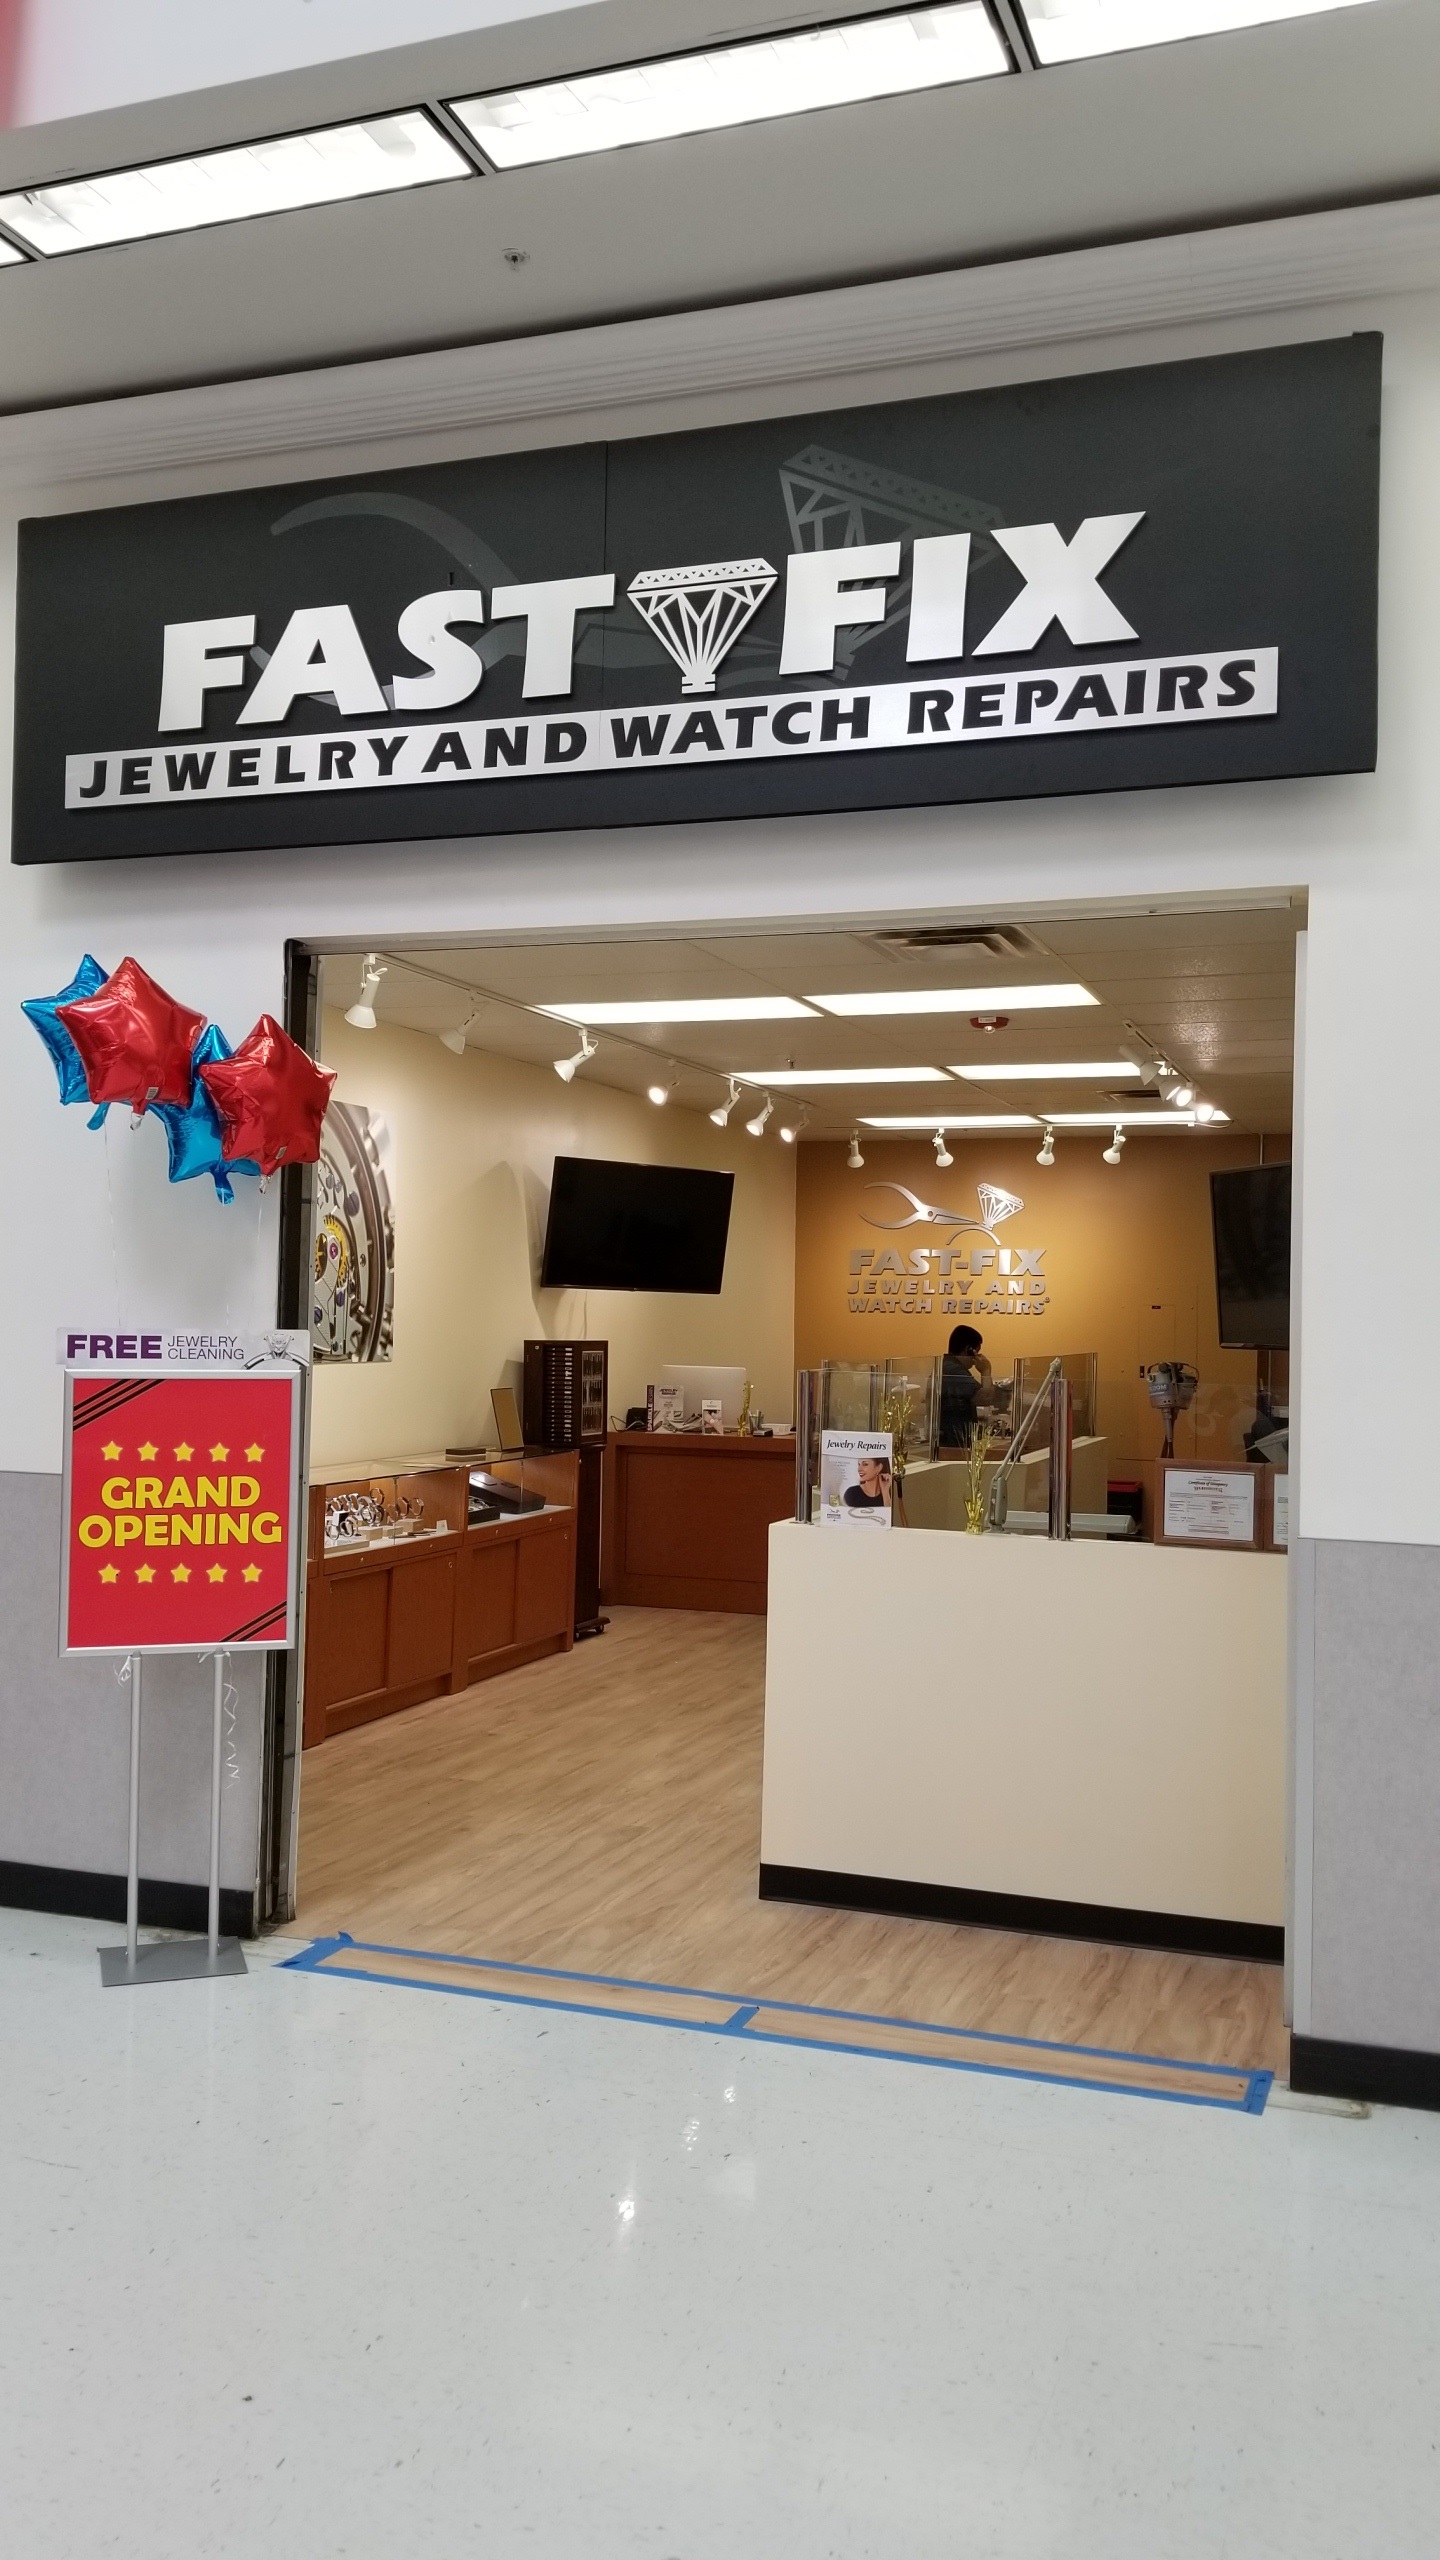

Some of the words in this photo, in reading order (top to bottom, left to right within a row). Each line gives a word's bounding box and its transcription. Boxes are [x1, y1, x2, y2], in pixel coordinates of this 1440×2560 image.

[158, 573, 616, 732] FAST
[778, 510, 1146, 675] FIX
[79, 735, 409, 798] JEWELRY
[421, 721, 588, 773] AND
[610, 696, 870, 759] WATCH
[906, 658, 1257, 732] REPAIRS
[849, 1248, 1046, 1276] FAST-FIX
[847, 1279, 973, 1295] JEWELRY
[985, 1280, 1046, 1295] AND
[849, 1298, 932, 1313] WATCH
[67, 1334, 162, 1360] FREE
[168, 1336, 238, 1348] JEWELRY
[168, 1348, 244, 1360] CLEANING
[827, 1439, 855, 1451] Jewelry
[857, 1440, 887, 1451] Repairs
[101, 1476, 261, 1509] GRAND
[78, 1512, 282, 1547] OPENING
